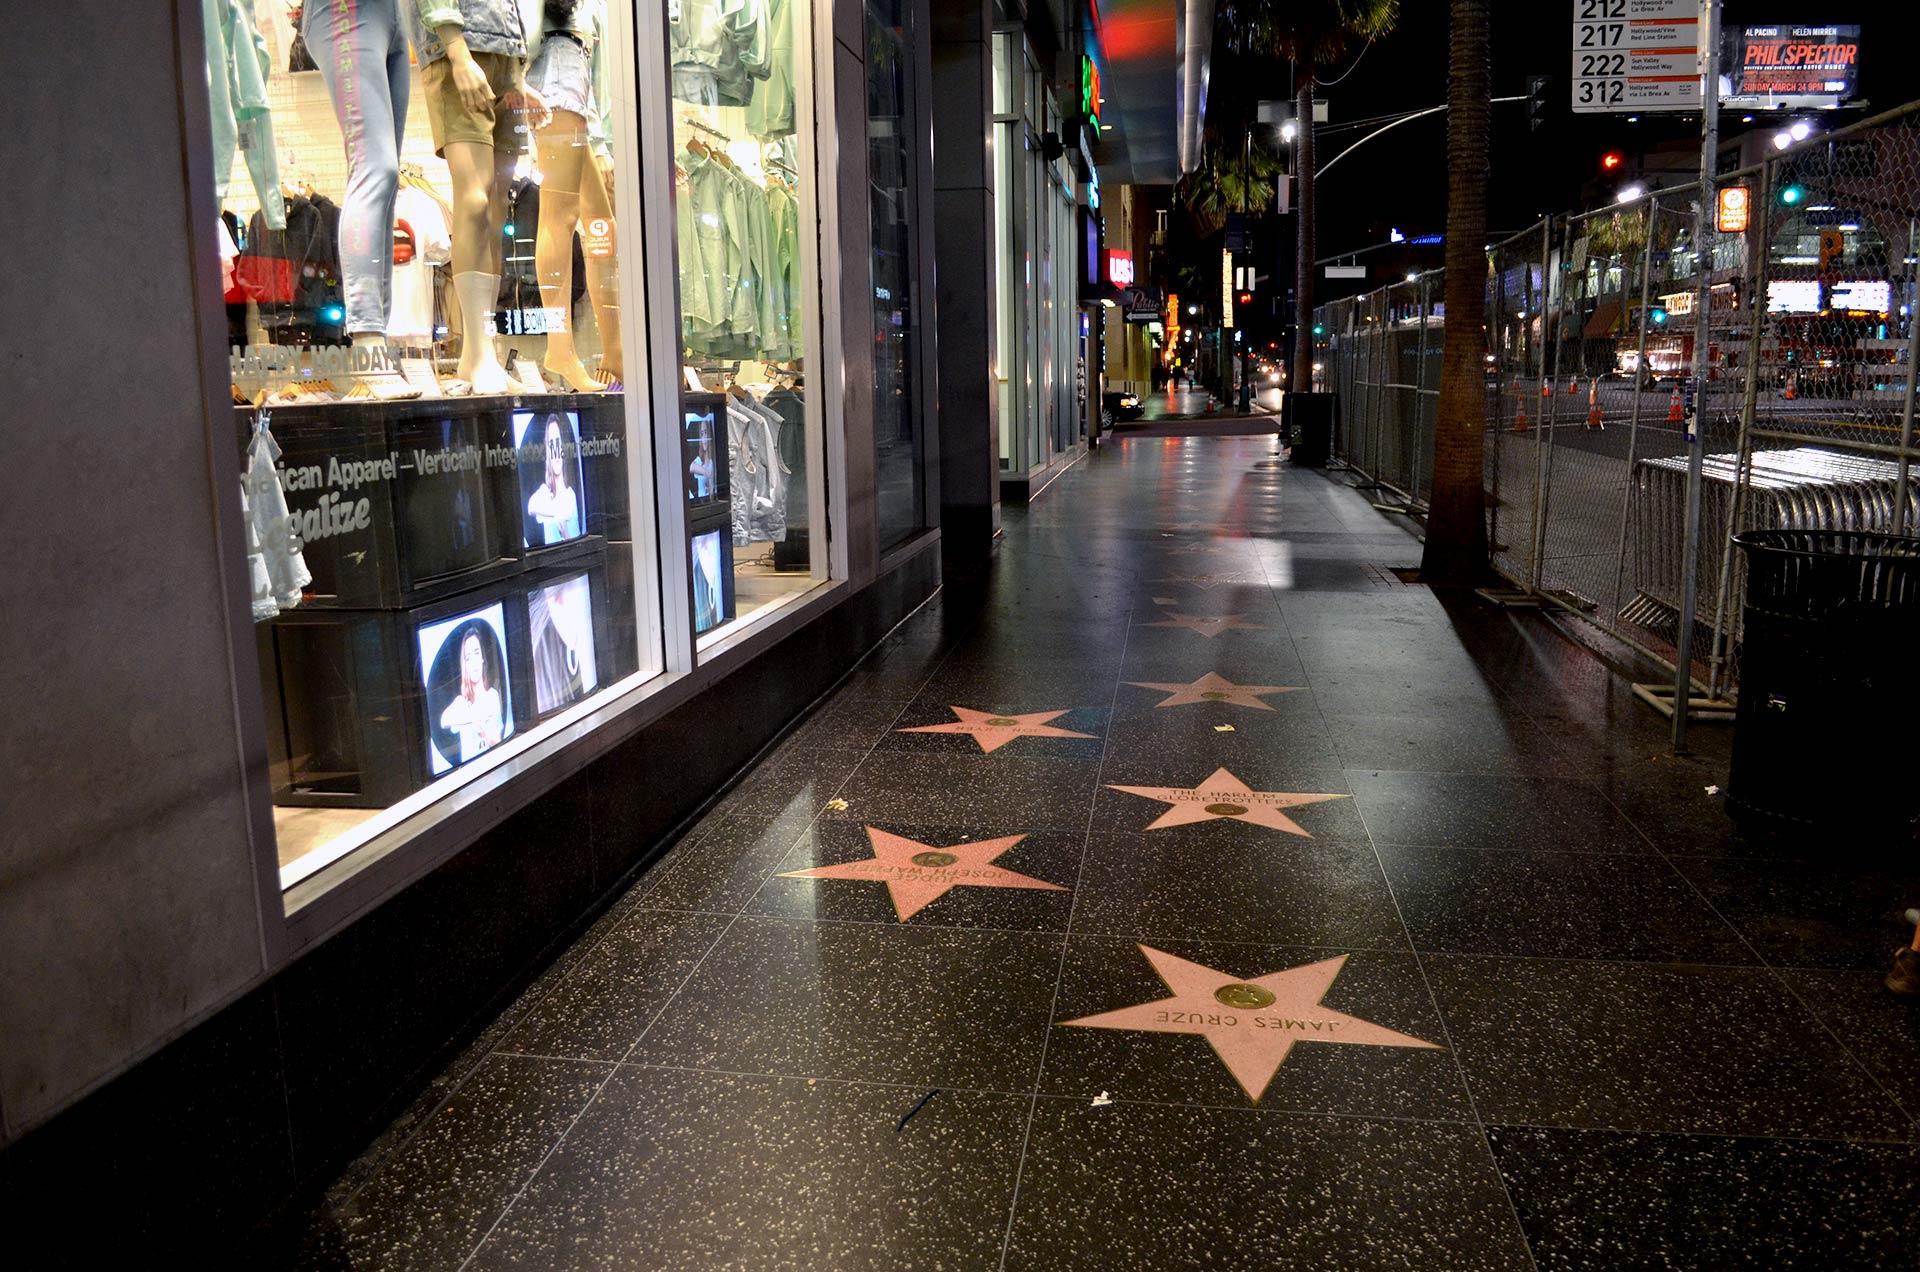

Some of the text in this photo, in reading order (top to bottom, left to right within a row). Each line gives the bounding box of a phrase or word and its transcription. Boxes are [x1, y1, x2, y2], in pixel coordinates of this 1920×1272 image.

[1581, 0, 1626, 18] 212
[1581, 24, 1624, 46] 217
[1745, 28, 1837, 36] AL PACINO HELEN MIRREN
[1581, 54, 1625, 76] 222
[1744, 44, 1857, 65] PHIL SPECTOR
[1579, 81, 1624, 103] 312
[1743, 82, 1771, 92] SUNDAY
[1771, 82, 1796, 91] MARCH
[1798, 82, 1807, 91] 24
[1808, 82, 1824, 91] 9PM
[1126, 289, 1160, 311] Public
[229, 345, 304, 377] HAPPY
[413, 443, 482, 475] Vertically
[1157, 794, 1293, 805] GLOBETROTTERS
[1210, 791, 1276, 799] HARLEM
[891, 872, 959, 883] JUDGE
[934, 868, 1009, 880] JOSEPH
[1156, 1009, 1341, 1034] JAMES CRUZE
